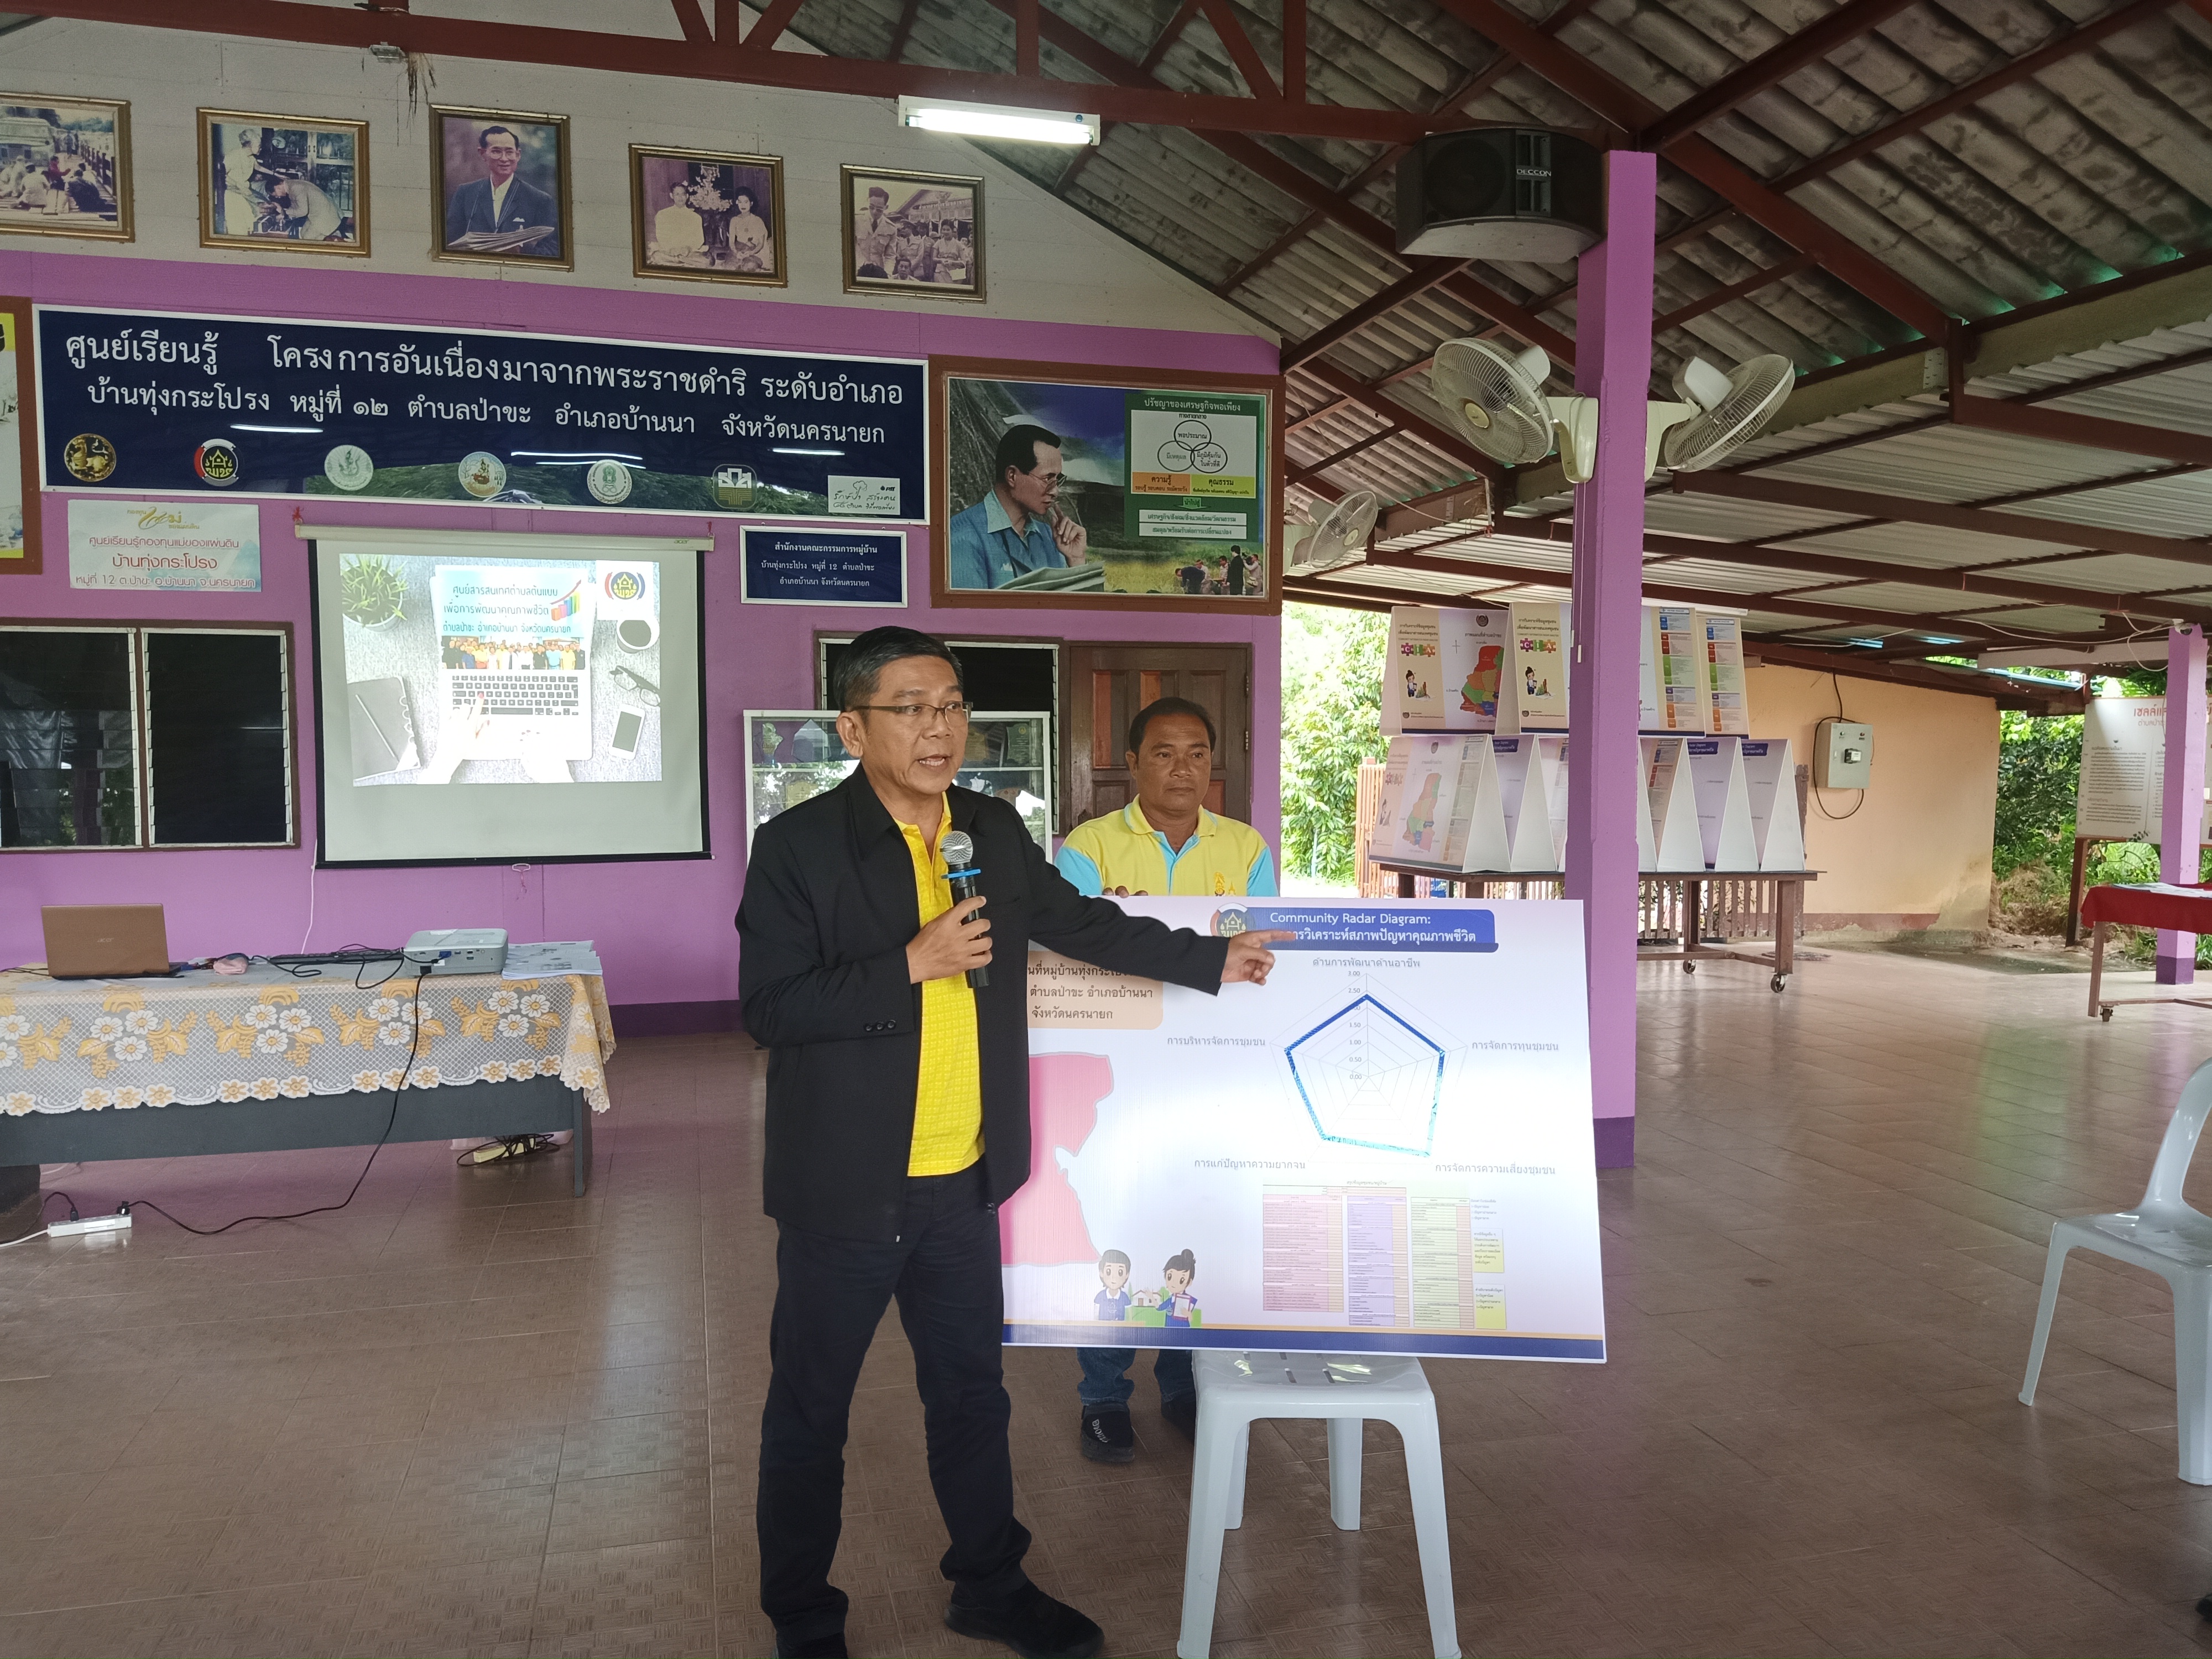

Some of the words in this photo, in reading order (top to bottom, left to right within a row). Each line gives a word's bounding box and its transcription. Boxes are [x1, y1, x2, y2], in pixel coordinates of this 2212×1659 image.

[1516, 169, 1551, 177] DECCON
[66, 329, 218, 374] ศูนย์เรียนรู้
[761, 371, 903, 404] ระดับอำเภอ
[88, 377, 270, 415] บ้านทุ่งกระโปรง
[290, 382, 342, 422] หมู่ที่
[353, 398, 389, 416] ๑๒
[409, 394, 531, 424] ตำบลป่าขะ
[555, 405, 695, 434] อำเภอบ้านนา
[722, 413, 884, 444] จังหวัดนครนายก
[1144, 398, 1240, 411] ปรัชญาของเศรษฐกิจพอเพียง
[1166, 452, 1186, 461] มีเหตุผล
[1151, 474, 1171, 486] ความรู้
[1209, 478, 1234, 487] คุณธรรม
[89, 536, 239, 548] ศูนย์เรียนรู้กองทุนแม่ของแผ่นดิน
[775, 542, 878, 555] สำนักงานคณะกรรมการหมู่บ้าน
[112, 553, 217, 571] บ้านทุ่งกระโปรง
[761, 560, 807, 571] บ้านทุ่งกระโปรง
[812, 560, 826, 572] หมู่ที่
[76, 573, 96, 585] หมู่ที่
[103, 575, 114, 585] 12
[119, 576, 150, 585] ต.ป่าขะ
[155, 575, 195, 586] อ.บ้านนา
[200, 577, 255, 587] จ.นครนายก
[780, 576, 818, 585] อำเภอบ้านนา
[821, 577, 869, 587] จังหวัดนครนายก
[453, 584, 558, 598] ศูนย์สารสนเทศตำบลต้นแบบ
[444, 599, 549, 618] เพื่อการพัฒนาคุณภาพชีวิต
[443, 622, 474, 632] ตำบลป่าขะ
[478, 622, 518, 633] อำเภอบ้านนา
[521, 623, 571, 633] จังหวัดนครนายก
[1270, 912, 1338, 926] Community
[1343, 913, 1375, 924] Radar
[1380, 914, 1431, 927] Diagram:
[1280, 927, 1476, 946] ารวิเคราะห์สภาพปัญหาคุณภาพชีวิต
[1313, 957, 1420, 968] ด้านการพัฒนาด้านอาชีพ
[1030, 984, 1083, 997] ตำบลป่าขะ
[1088, 984, 1152, 998] อำเภอบ้านนา
[1032, 1005, 1113, 1019] จังหวัดนครนายก
[1167, 1036, 1265, 1047] การบริหารจัดการชุมชน
[1472, 1040, 1559, 1052] การจัดการทุนชุมชน
[1194, 1158, 1306, 1170] การแก้ปัญหาความยากจน
[1436, 1162, 1556, 1176] การจัดการความเสี่ยงชุมชน
